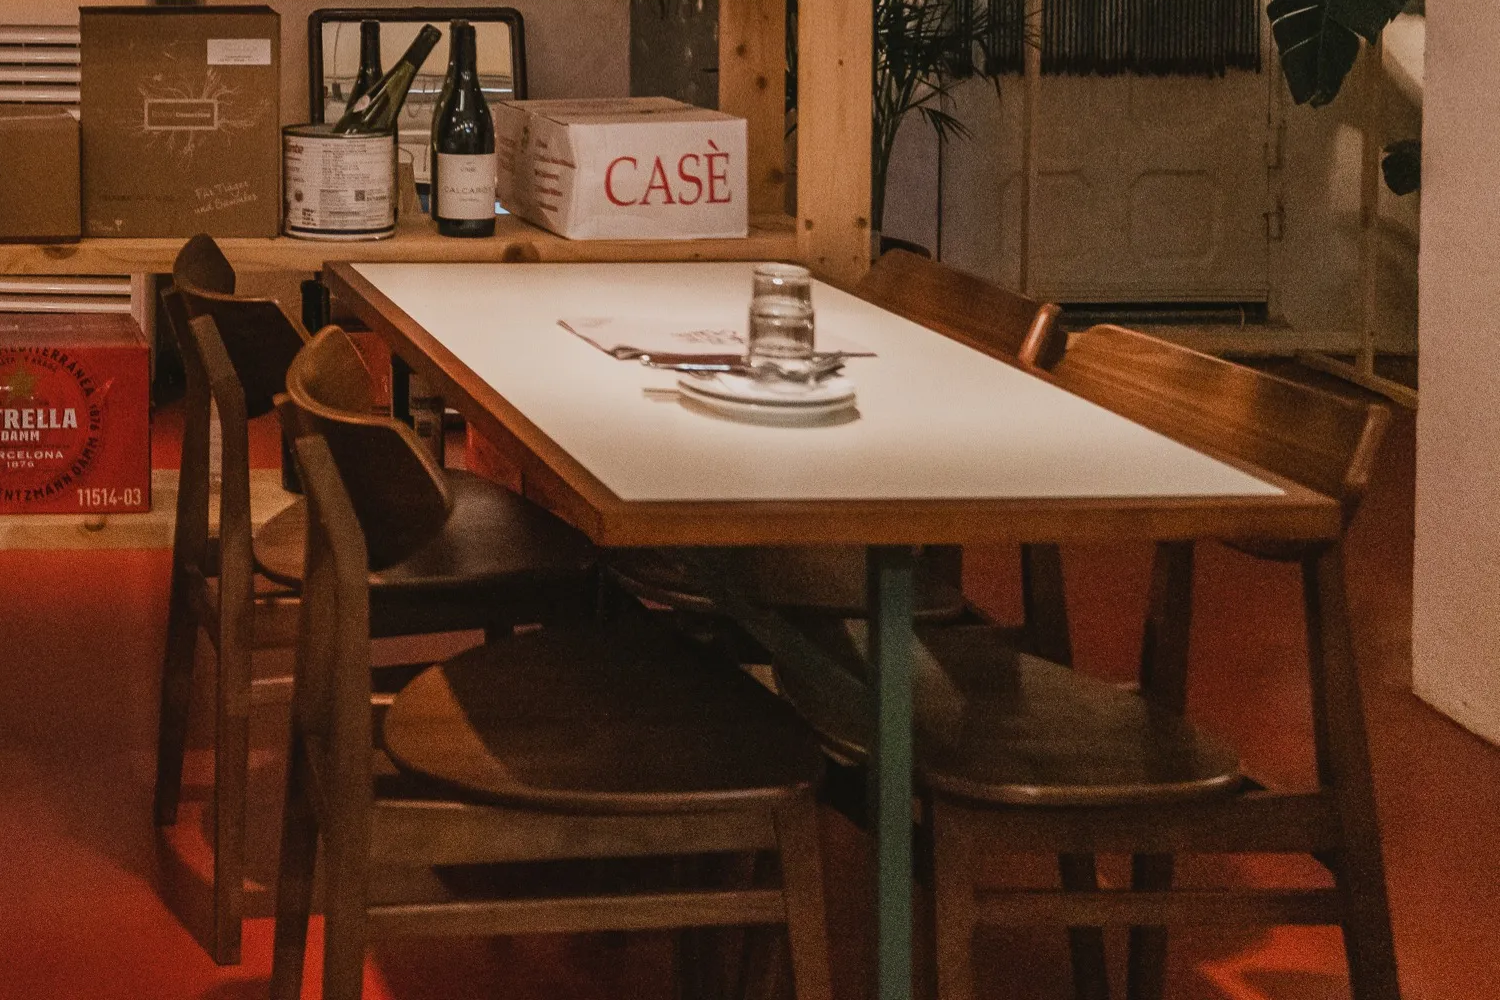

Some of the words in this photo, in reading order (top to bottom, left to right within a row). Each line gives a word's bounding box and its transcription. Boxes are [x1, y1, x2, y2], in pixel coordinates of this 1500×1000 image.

[604, 139, 732, 207] CASÈ
[0, 430, 40, 441] DAMM
[76, 487, 142, 507] 11514-03
